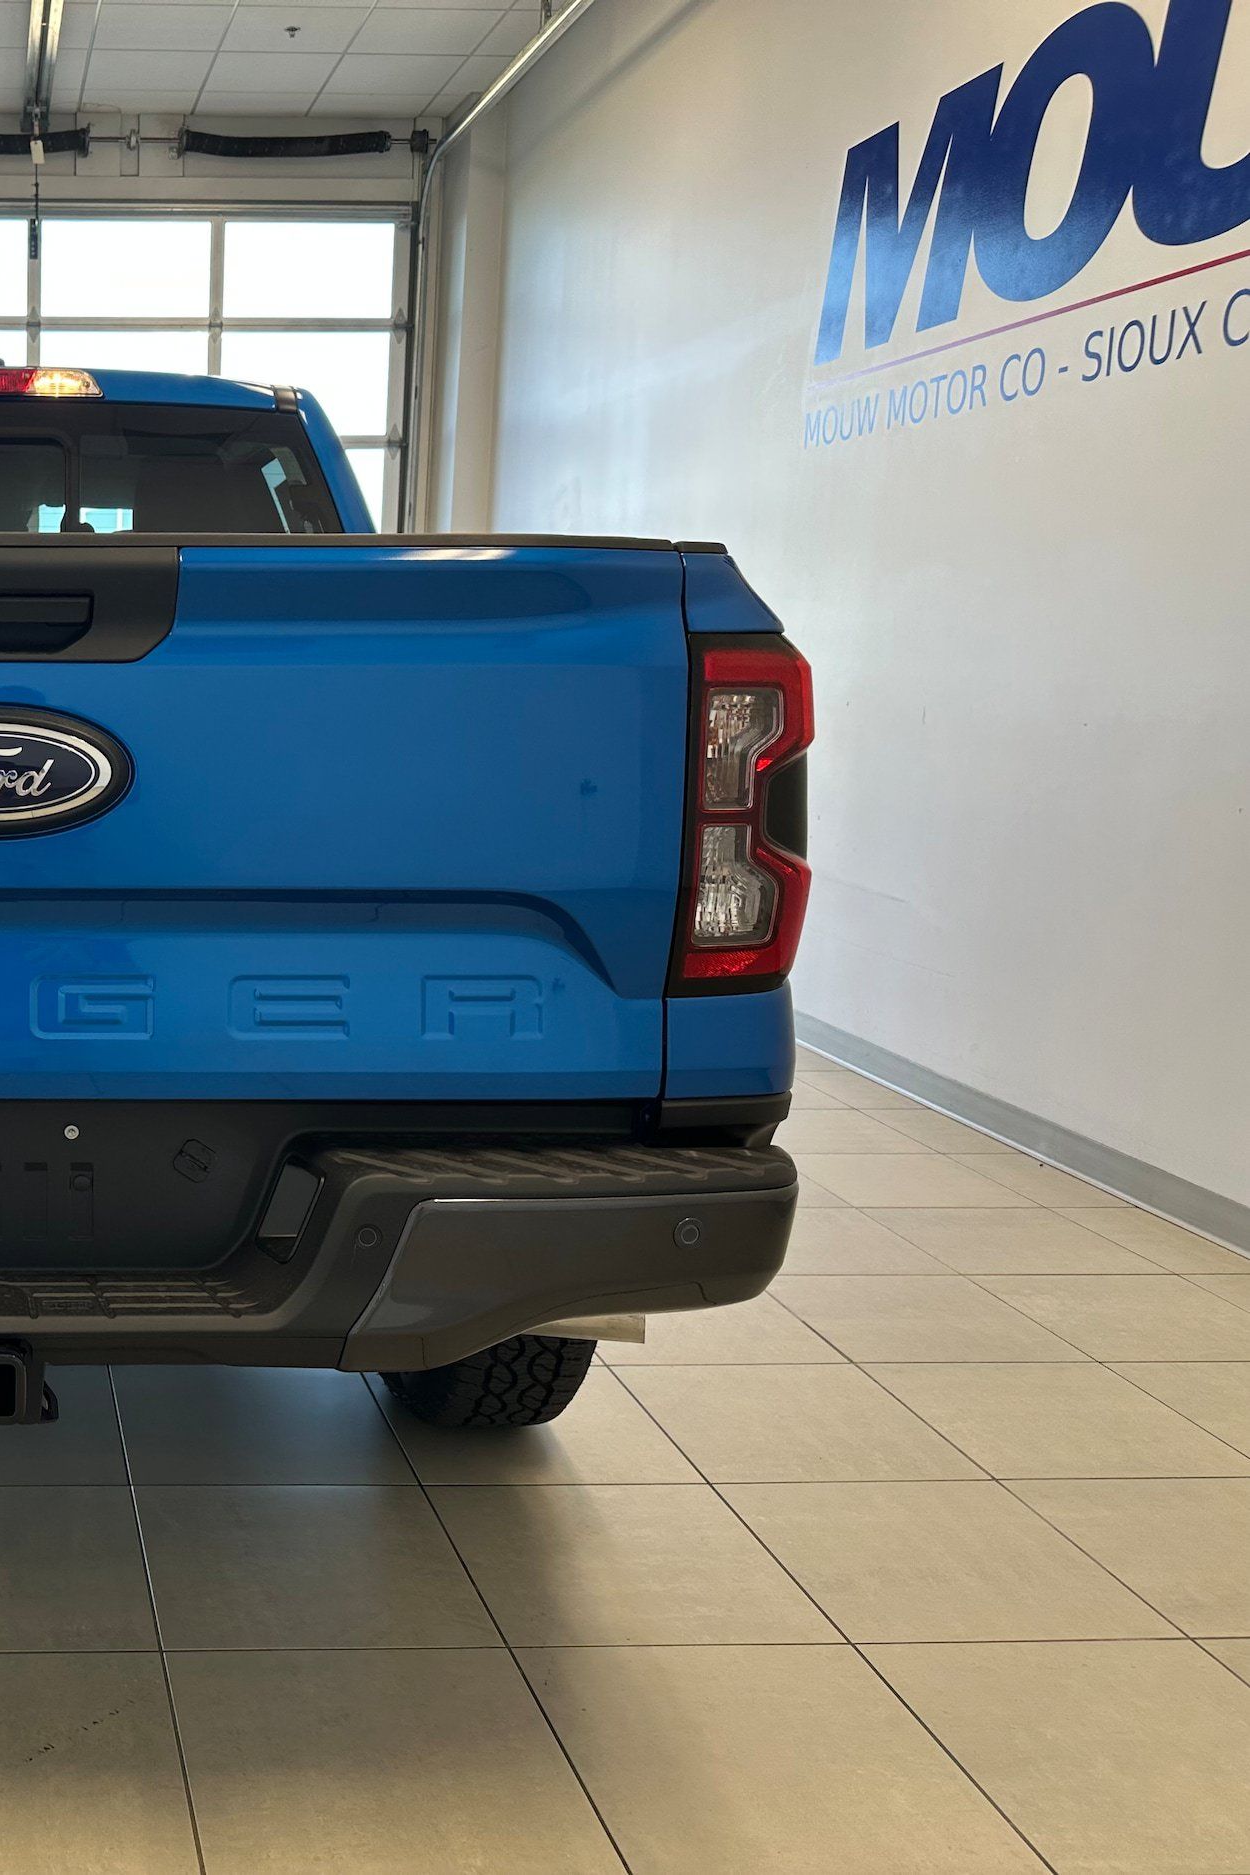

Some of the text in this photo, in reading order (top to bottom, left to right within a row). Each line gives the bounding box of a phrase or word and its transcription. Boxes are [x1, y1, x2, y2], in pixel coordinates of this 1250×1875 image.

[804, 393, 880, 449] MOUW
[887, 364, 987, 430] MOTOR
[1000, 347, 1046, 401] CO
[1081, 300, 1207, 382] SIOUX
